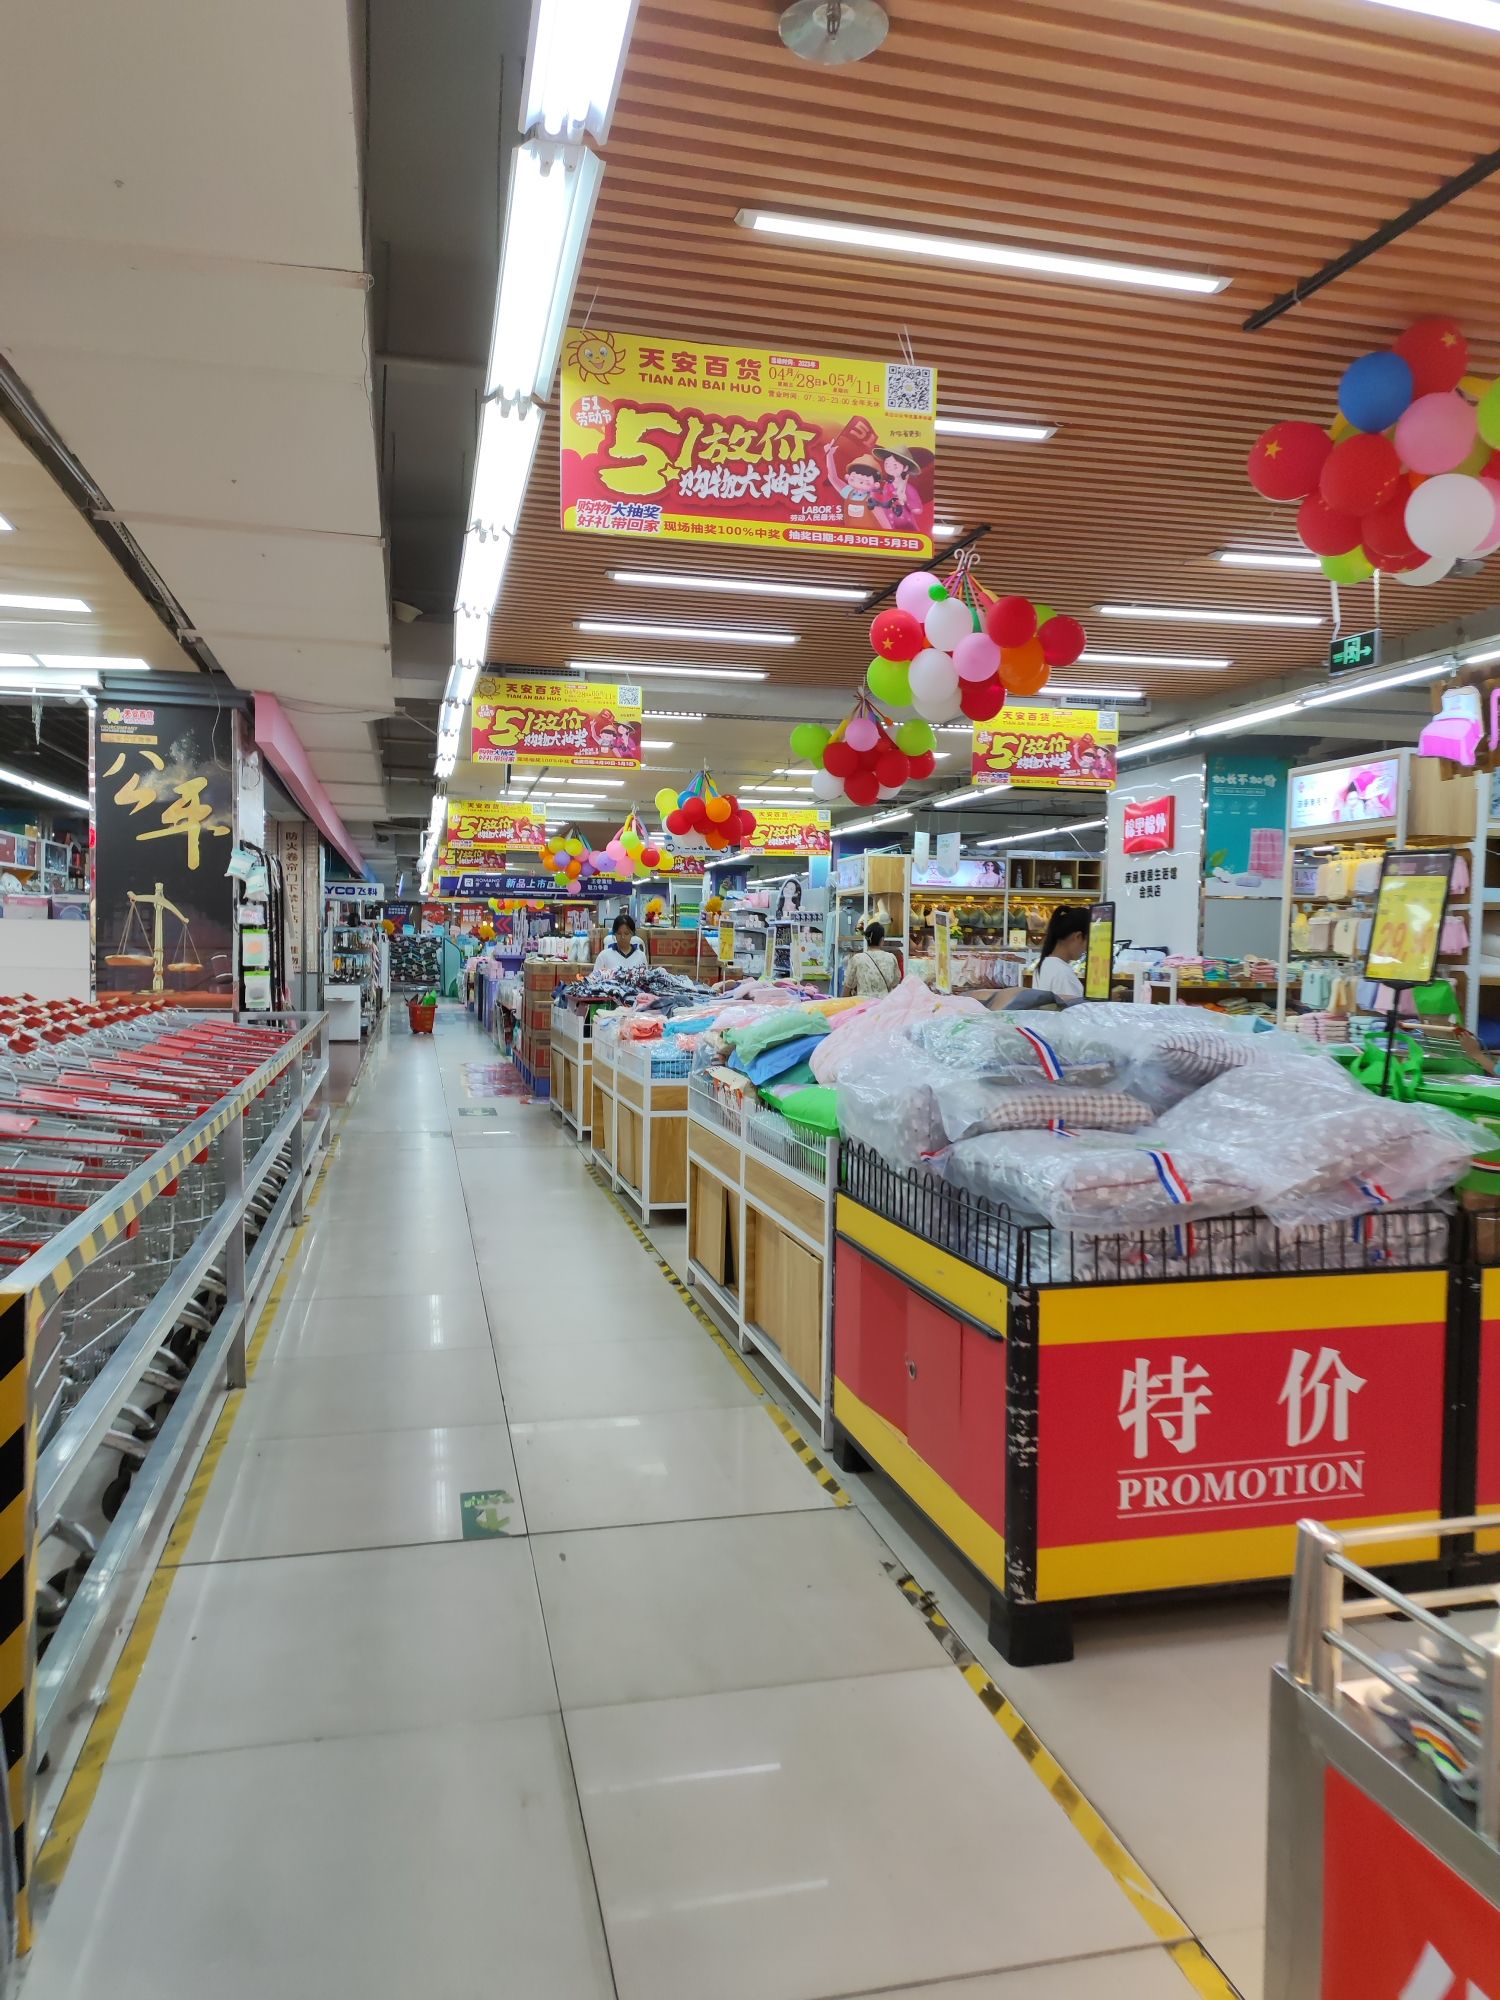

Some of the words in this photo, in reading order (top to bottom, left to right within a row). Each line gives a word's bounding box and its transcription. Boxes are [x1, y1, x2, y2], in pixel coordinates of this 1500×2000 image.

[638, 347, 762, 382] 天安百货
[638, 373, 674, 385] TIAN
[677, 376, 699, 388] AN
[702, 379, 726, 391] BAI
[729, 383, 762, 395] HUO
[580, 395, 601, 411] 51
[576, 409, 613, 427] 劳动节
[679, 459, 821, 504] 购物大抽奖
[577, 500, 661, 520] 购物大抽奖
[577, 514, 661, 533] 好礼带回家
[664, 520, 781, 540] 现场抽奖100%中奖
[506, 683, 561, 696] 天安百货
[1003, 711, 1050, 721] 天安百货
[505, 878, 546, 888] 新品上市
[1118, 1346, 1367, 1460] 特价
[1117, 1458, 1366, 1511] PROMOTION
